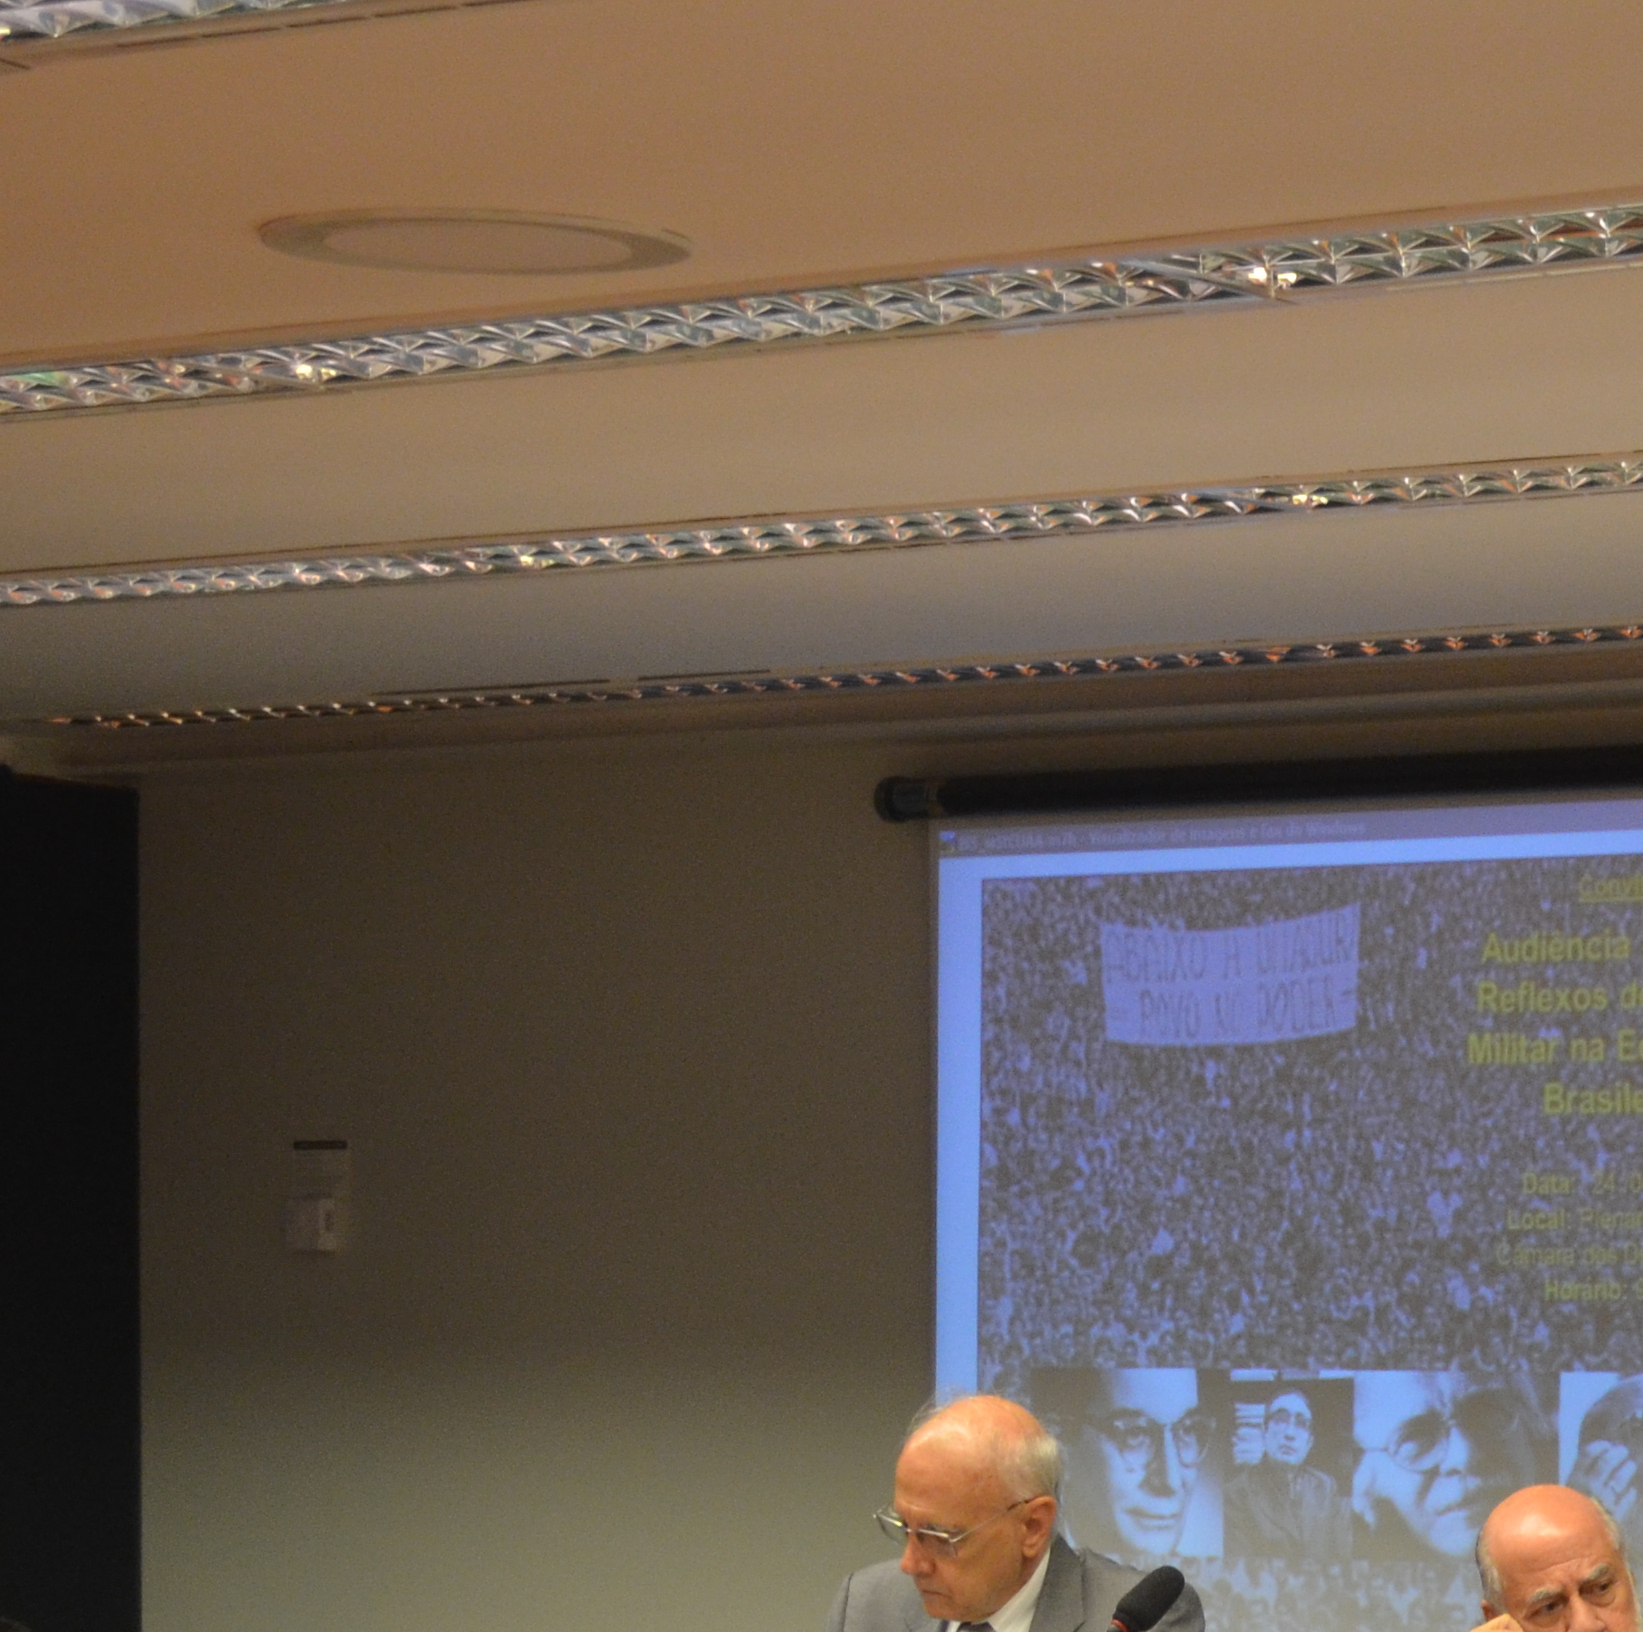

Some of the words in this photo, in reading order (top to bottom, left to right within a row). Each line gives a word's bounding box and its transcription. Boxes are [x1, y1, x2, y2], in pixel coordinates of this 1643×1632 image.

[1482, 929, 1631, 963] Audiência
[1477, 980, 1609, 1013] Reflexos
[1467, 1032, 1560, 1065] Militar
[1569, 1036, 1606, 1062] na
